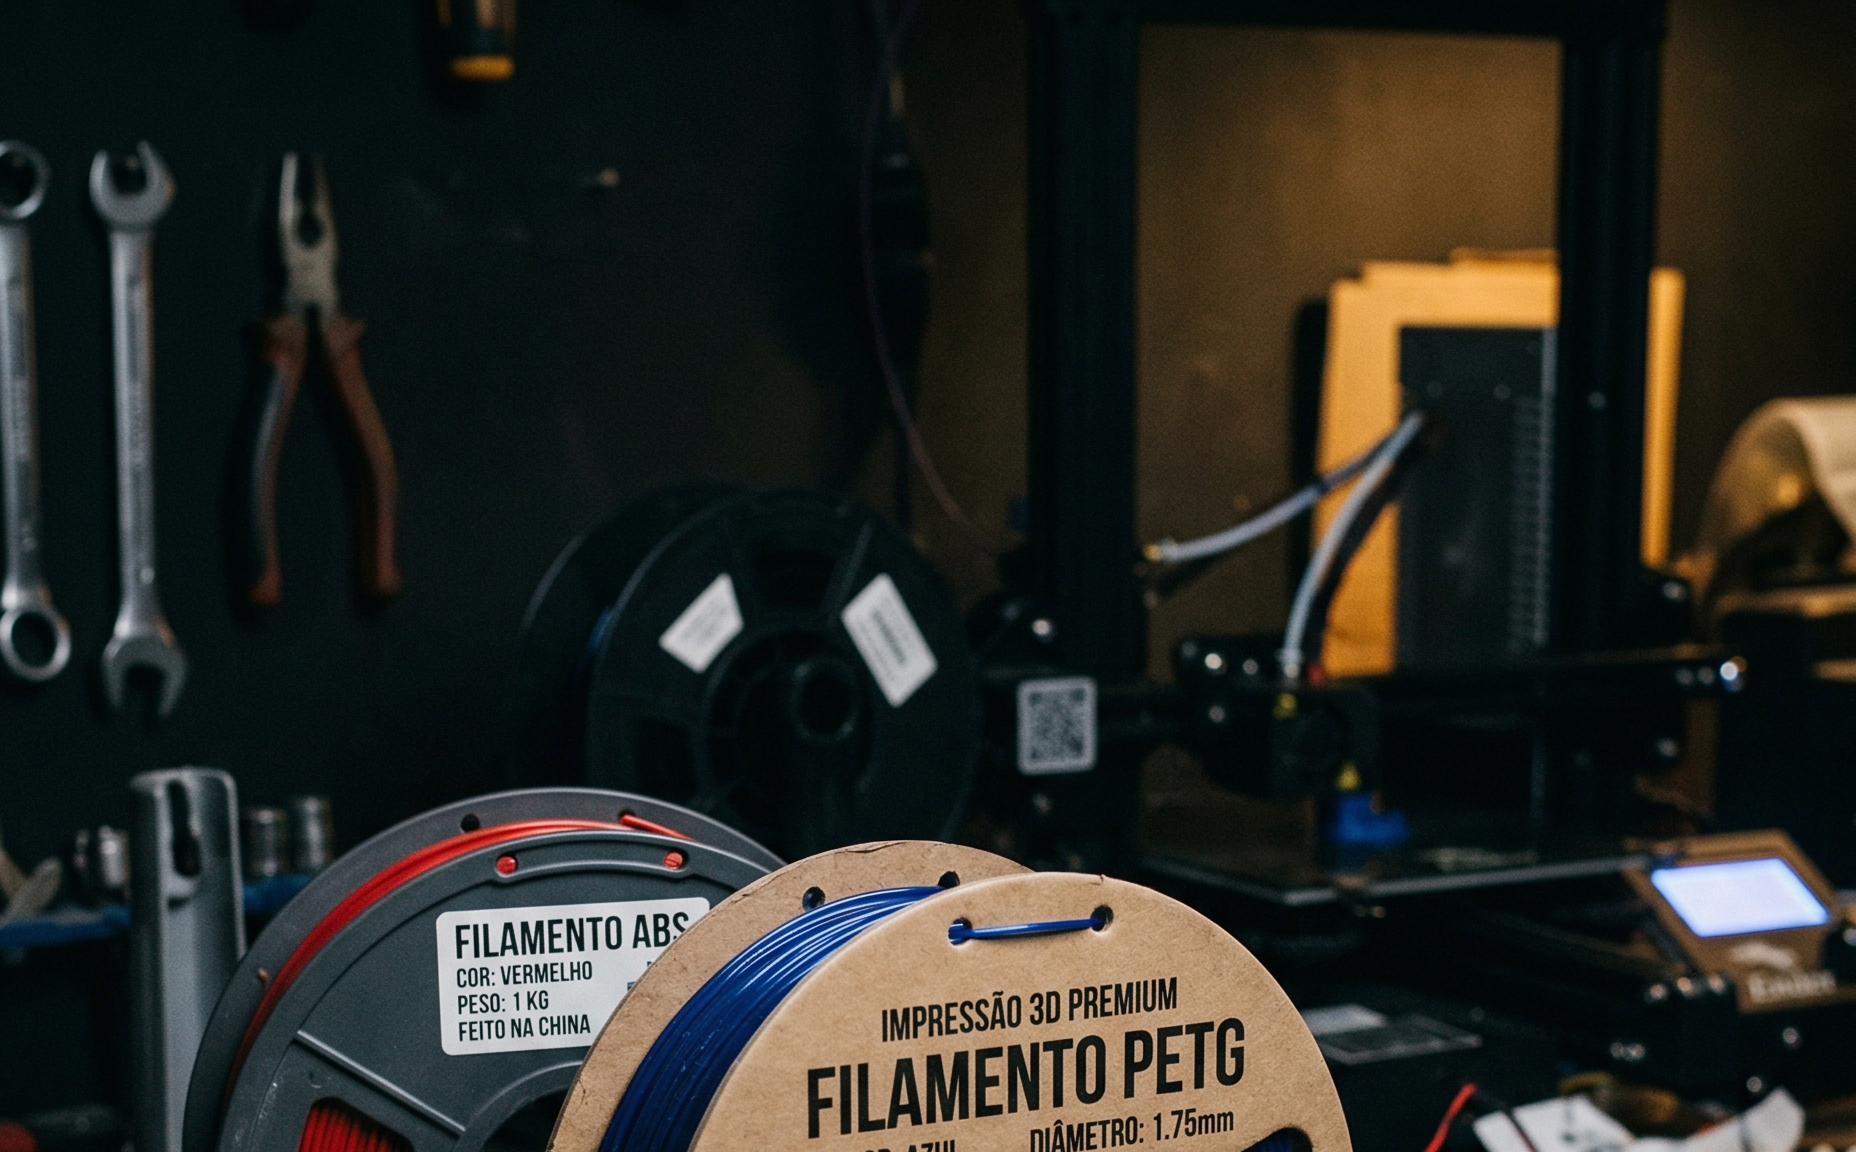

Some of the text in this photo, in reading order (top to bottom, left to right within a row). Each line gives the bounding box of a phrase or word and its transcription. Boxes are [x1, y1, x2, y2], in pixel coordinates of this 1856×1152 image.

[455, 911, 689, 959] FILAMENTO ABS
[456, 960, 593, 988] COR: VERMELHO
[458, 990, 549, 1015] PESO: 1 KG
[881, 977, 1178, 1042] IMPRESSÃO 3D PREMIUM
[458, 1014, 591, 1042] FEITO NA CHINA
[807, 1017, 1245, 1139] FILAMENTO PETG
[1153, 1107, 1235, 1142] 1.75mm
